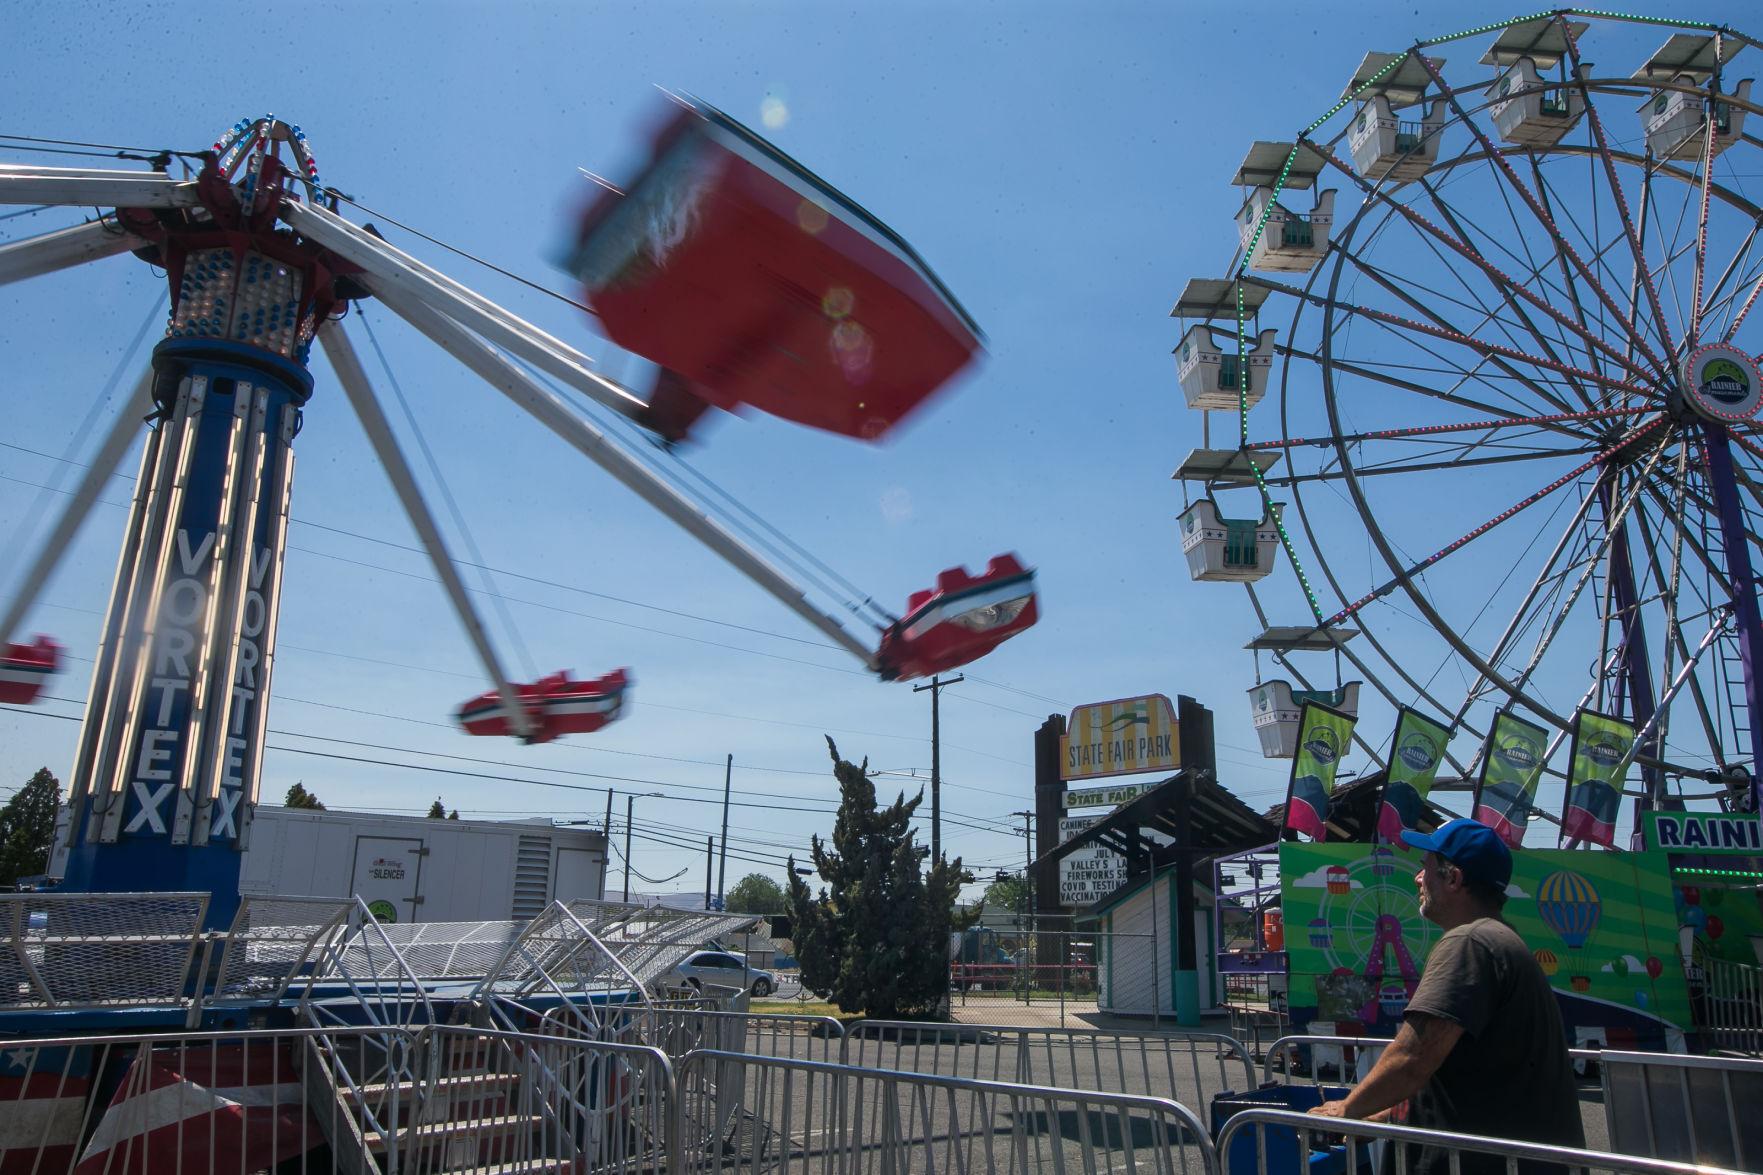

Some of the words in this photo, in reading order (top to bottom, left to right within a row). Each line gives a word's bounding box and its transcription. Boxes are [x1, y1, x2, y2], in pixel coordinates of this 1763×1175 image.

[123, 528, 216, 834] VORTEX
[210, 546, 272, 839] VORTEX
[1069, 742, 1104, 768] STATE
[1108, 737, 1135, 763] FAIR
[1139, 734, 1172, 759] PARK
[1067, 791, 1104, 806] STATE
[1108, 786, 1138, 803] FAIR
[1655, 816, 1763, 851] RAINI
[373, 868, 405, 880] SILENCER
[1061, 882, 1087, 892] COVID
[1067, 870, 1115, 881] FIREWORKS
